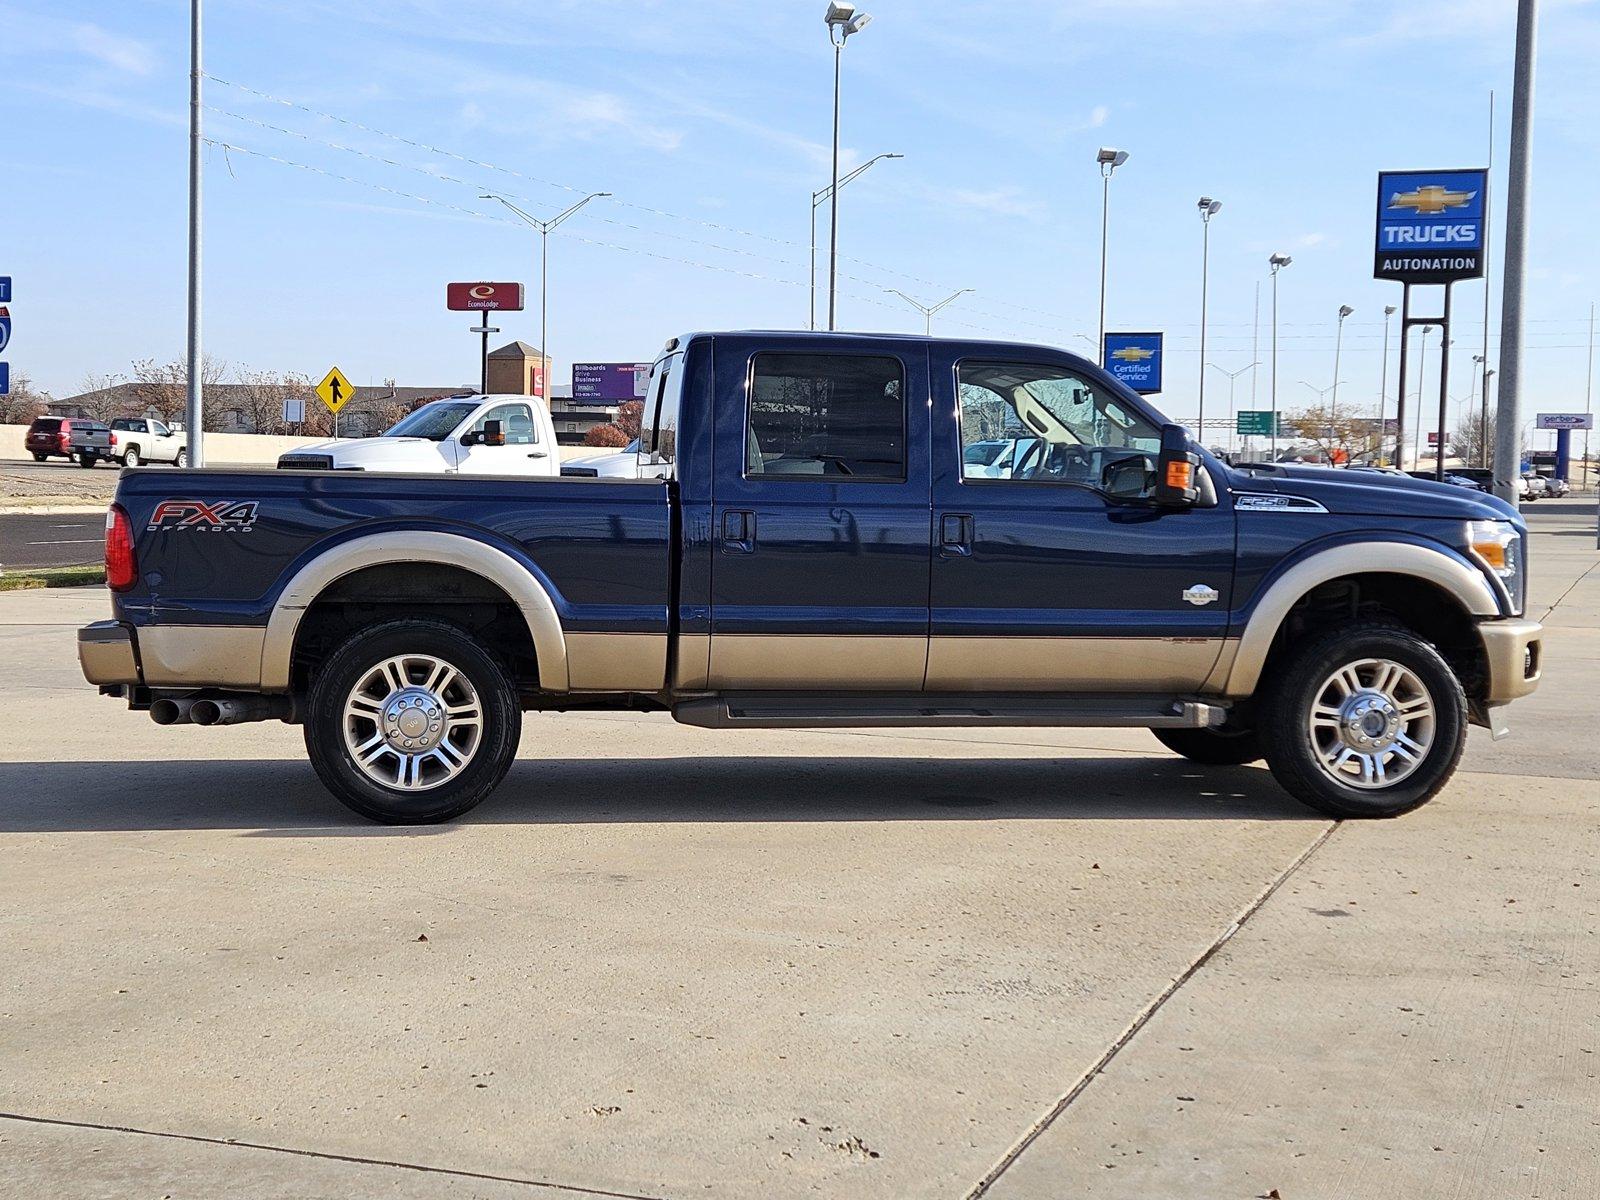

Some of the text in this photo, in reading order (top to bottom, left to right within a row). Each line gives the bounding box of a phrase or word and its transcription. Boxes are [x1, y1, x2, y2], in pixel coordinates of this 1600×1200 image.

[1384, 225, 1476, 243] TRUCKS
[1383, 258, 1476, 270] AUTONATION
[1113, 364, 1151, 373] Certified
[1116, 373, 1148, 381] Service
[1544, 416, 1576, 424] gerber
[148, 500, 260, 526] FX4
